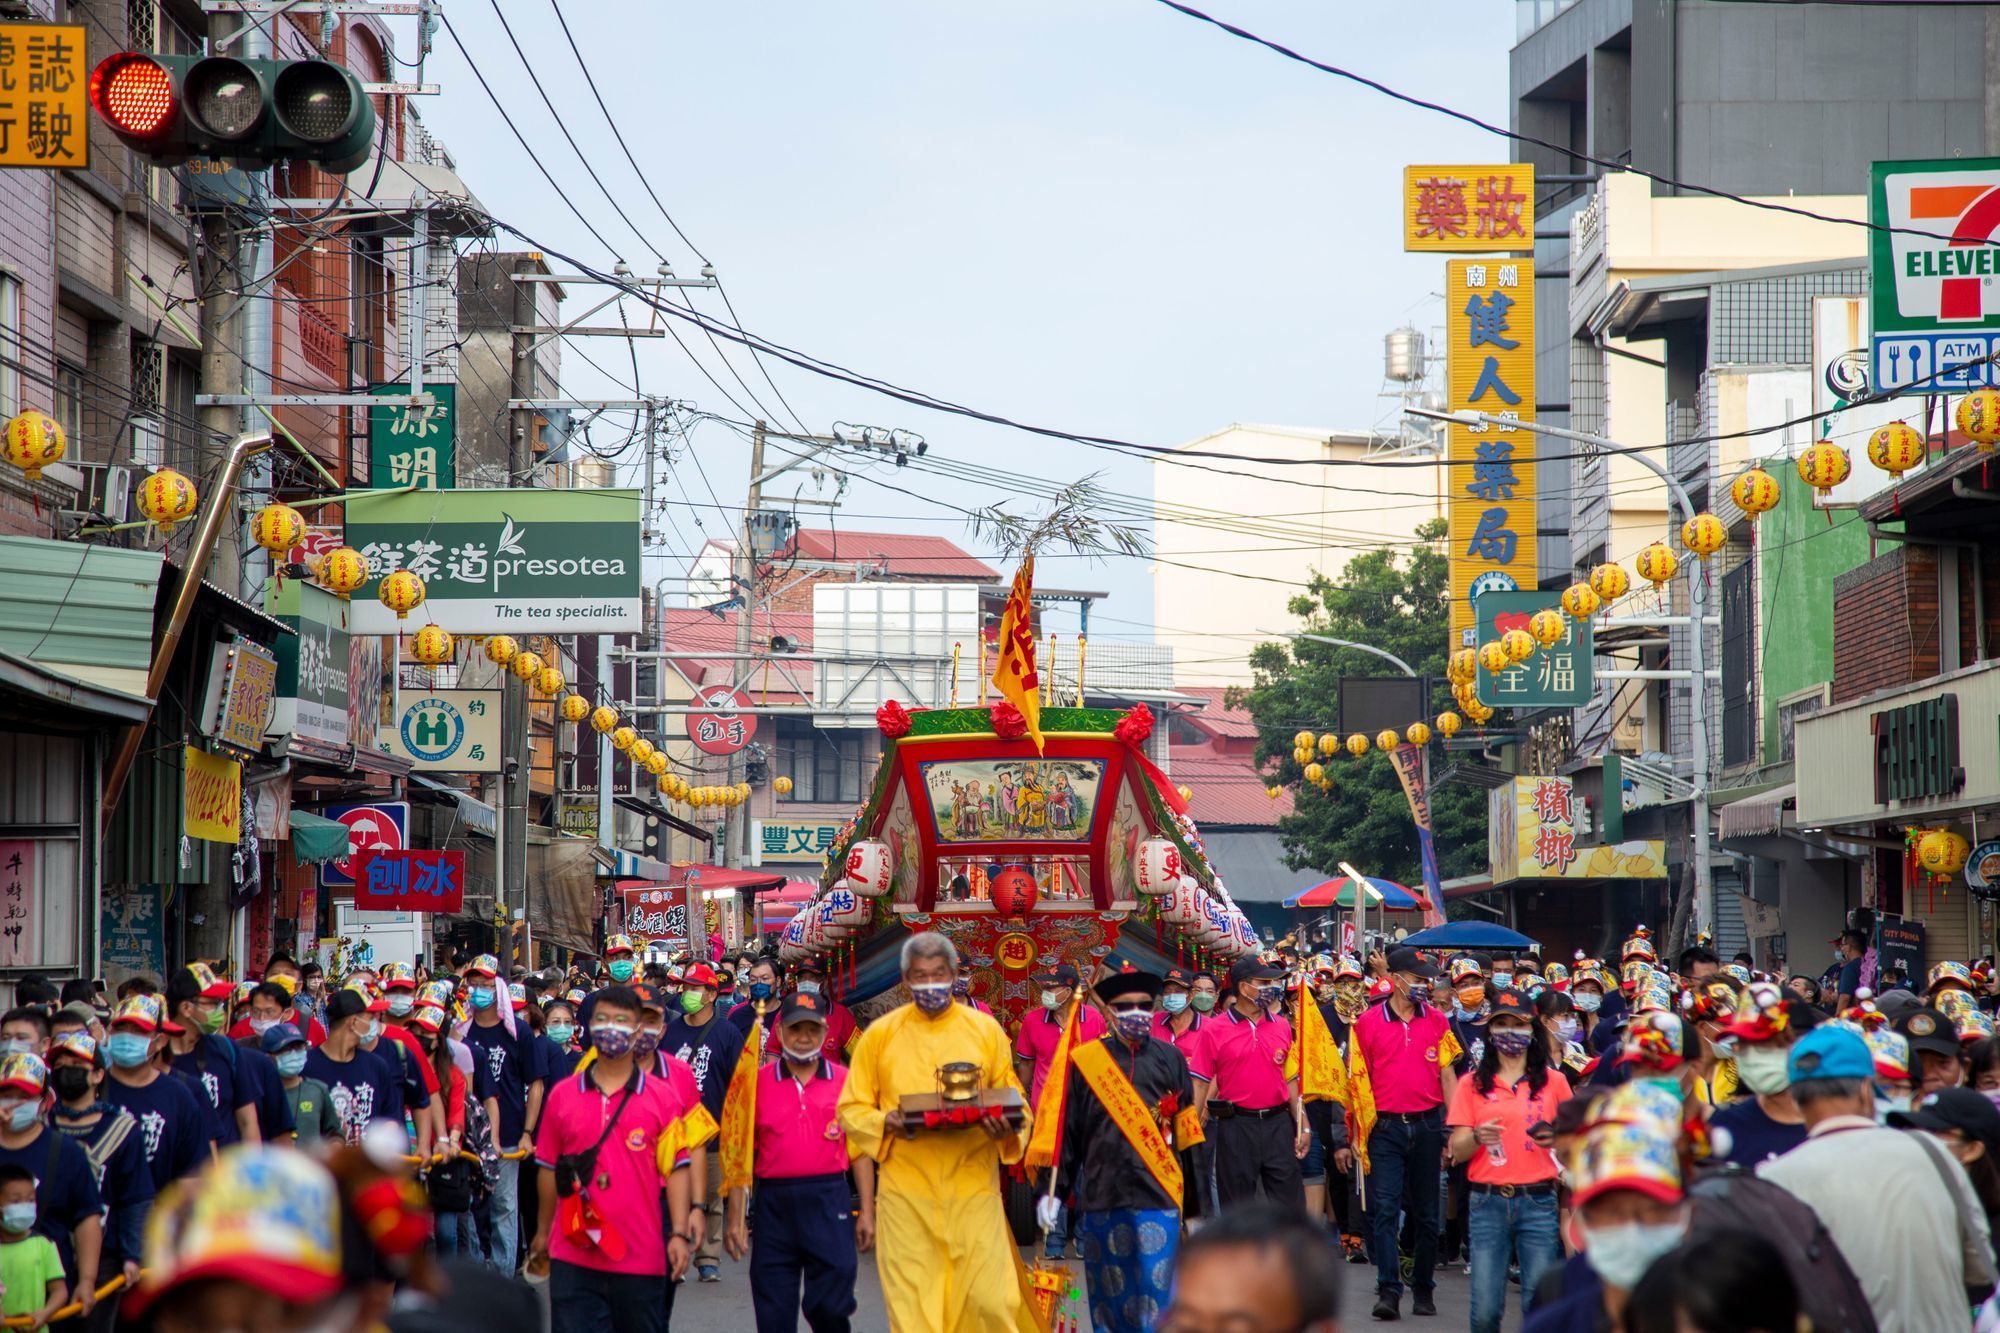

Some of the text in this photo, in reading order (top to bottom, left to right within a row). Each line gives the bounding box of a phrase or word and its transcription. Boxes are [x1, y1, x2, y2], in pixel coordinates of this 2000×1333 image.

[1465, 264, 1519, 288] 南州
[1906, 250, 2000, 278] ELEVE
[1464, 289, 1523, 406] 健人
[1942, 343, 1981, 358] ATM
[361, 539, 489, 584] 鮮茶道
[493, 556, 627, 593] presotea
[494, 604, 629, 620] The tea specialist.
[419, 753, 440, 761] HEALTH
[581, 784, 628, 792] 08-8841
[762, 825, 844, 855] 豐文具
[365, 854, 456, 898] 刨冰
[1884, 929, 1899, 939] CITY
